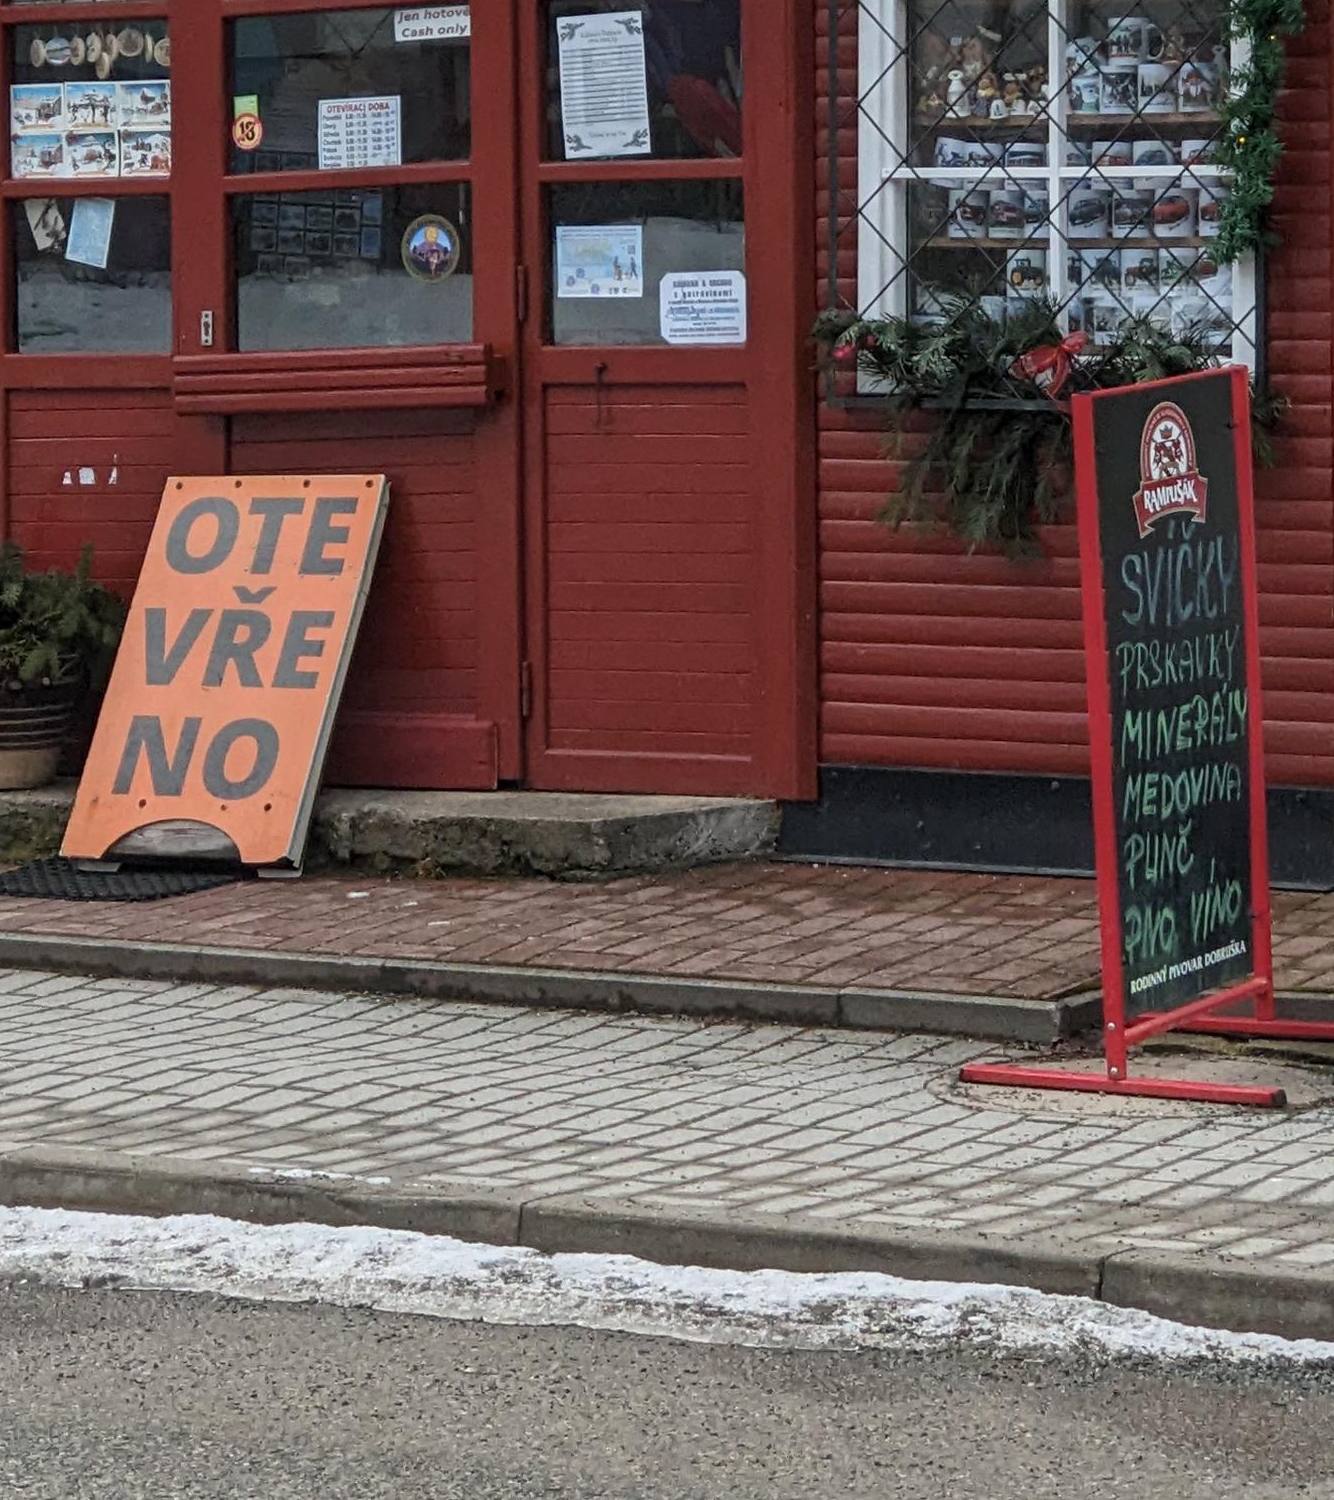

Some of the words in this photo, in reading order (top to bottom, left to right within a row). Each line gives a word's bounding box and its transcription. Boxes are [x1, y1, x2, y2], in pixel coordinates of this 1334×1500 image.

[402, 26, 434, 38] Cash
[437, 23, 468, 35] only
[240, 121, 255, 140] 18
[1143, 479, 1199, 514] RAMPUŠÁK
[165, 496, 360, 577] OTE
[1121, 518, 1239, 627] SVÍČKY
[143, 585, 336, 690] VŘE
[1116, 624, 1240, 698] PRSKAVKY
[111, 714, 280, 801] NO
[1121, 682, 1247, 768] MINERÁLY
[1123, 761, 1242, 823] MEDOVINA
[1123, 818, 1194, 890] PUNČ
[1190, 857, 1242, 945] VÍNO
[1168, 955, 1204, 980] PIVOVAR
[1204, 940, 1247, 967] DOBRUŠKA
